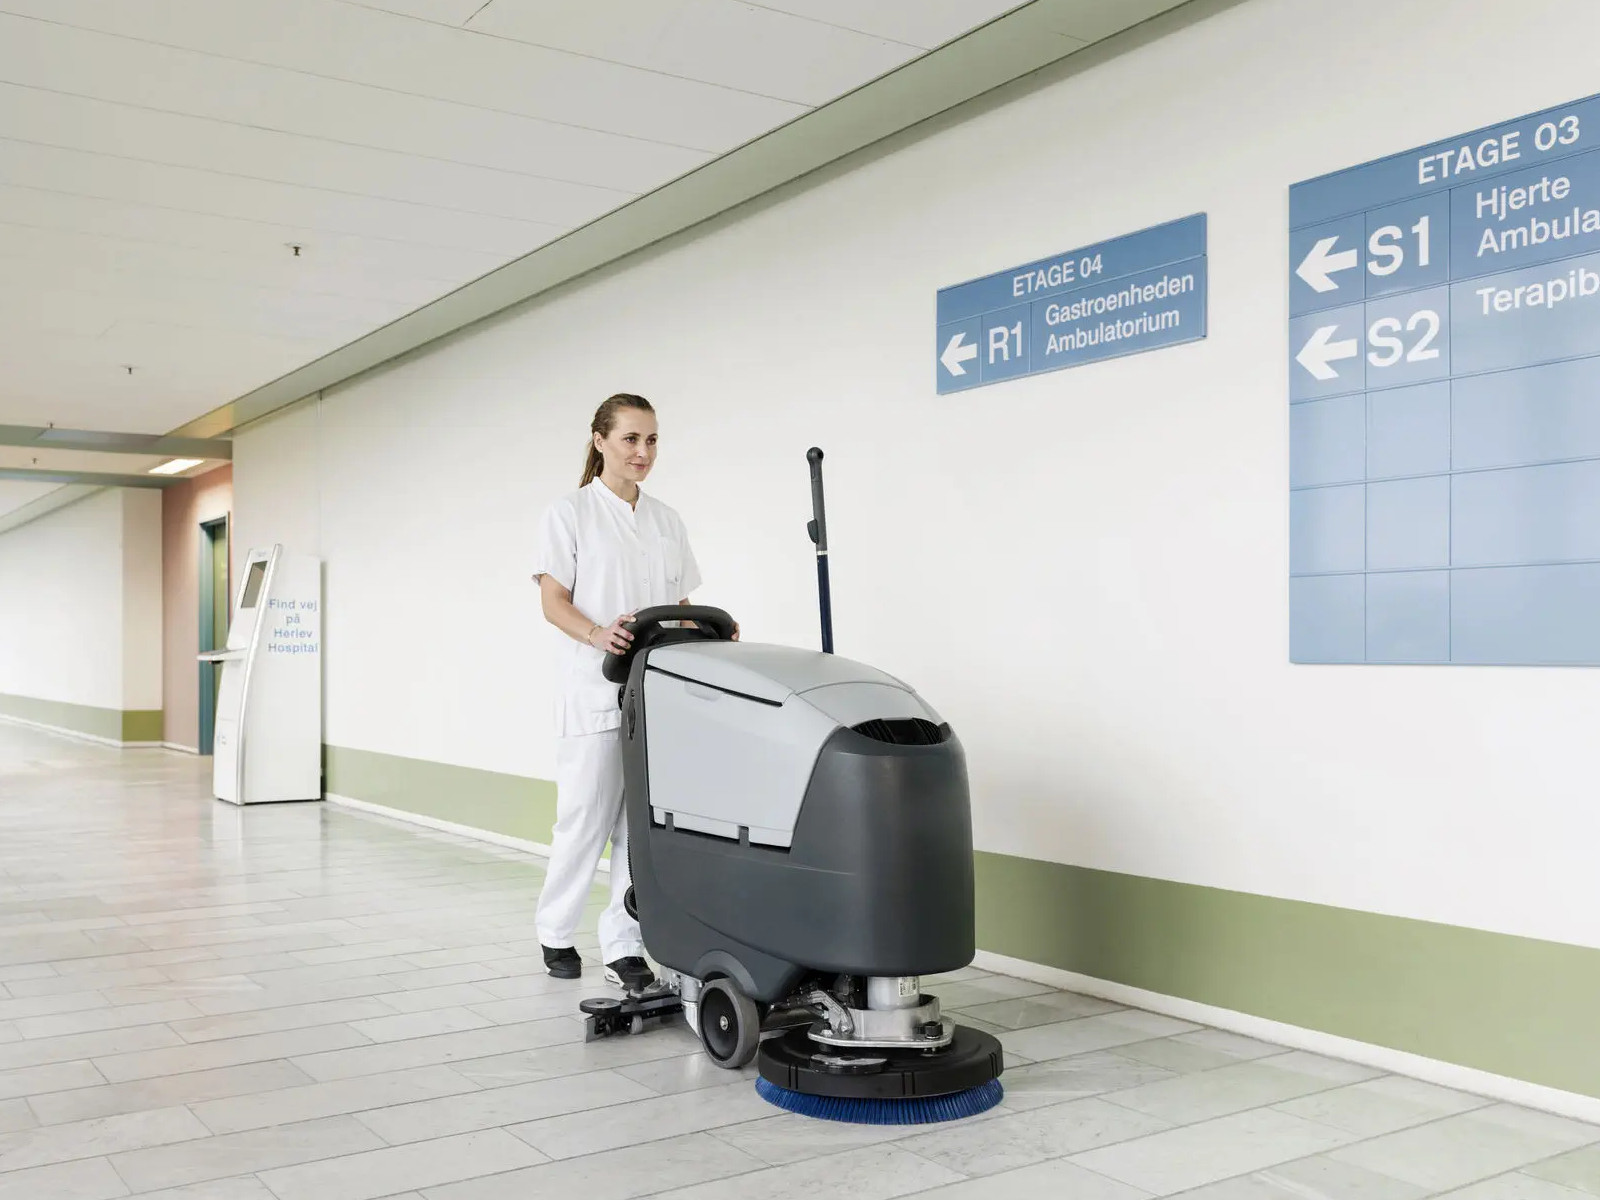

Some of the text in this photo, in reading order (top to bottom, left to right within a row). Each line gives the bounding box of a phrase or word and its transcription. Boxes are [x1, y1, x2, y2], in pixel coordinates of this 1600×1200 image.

[1418, 115, 1580, 185] ETAGE 03
[1475, 176, 1571, 221] Hjerte
[1367, 214, 1430, 276] S1
[1476, 206, 1600, 257] Ambula
[1013, 254, 1103, 297] ETAGE 04
[1475, 268, 1600, 315] Terapib
[1046, 274, 1194, 326] Gastroenheden
[988, 321, 1022, 364] R1
[1046, 309, 1180, 356] Ambulatorium
[1367, 309, 1440, 367] S2
[268, 599, 317, 612] Find vej
[286, 613, 300, 626] på
[268, 643, 318, 654] Hospital
[274, 629, 313, 638] Herlev
